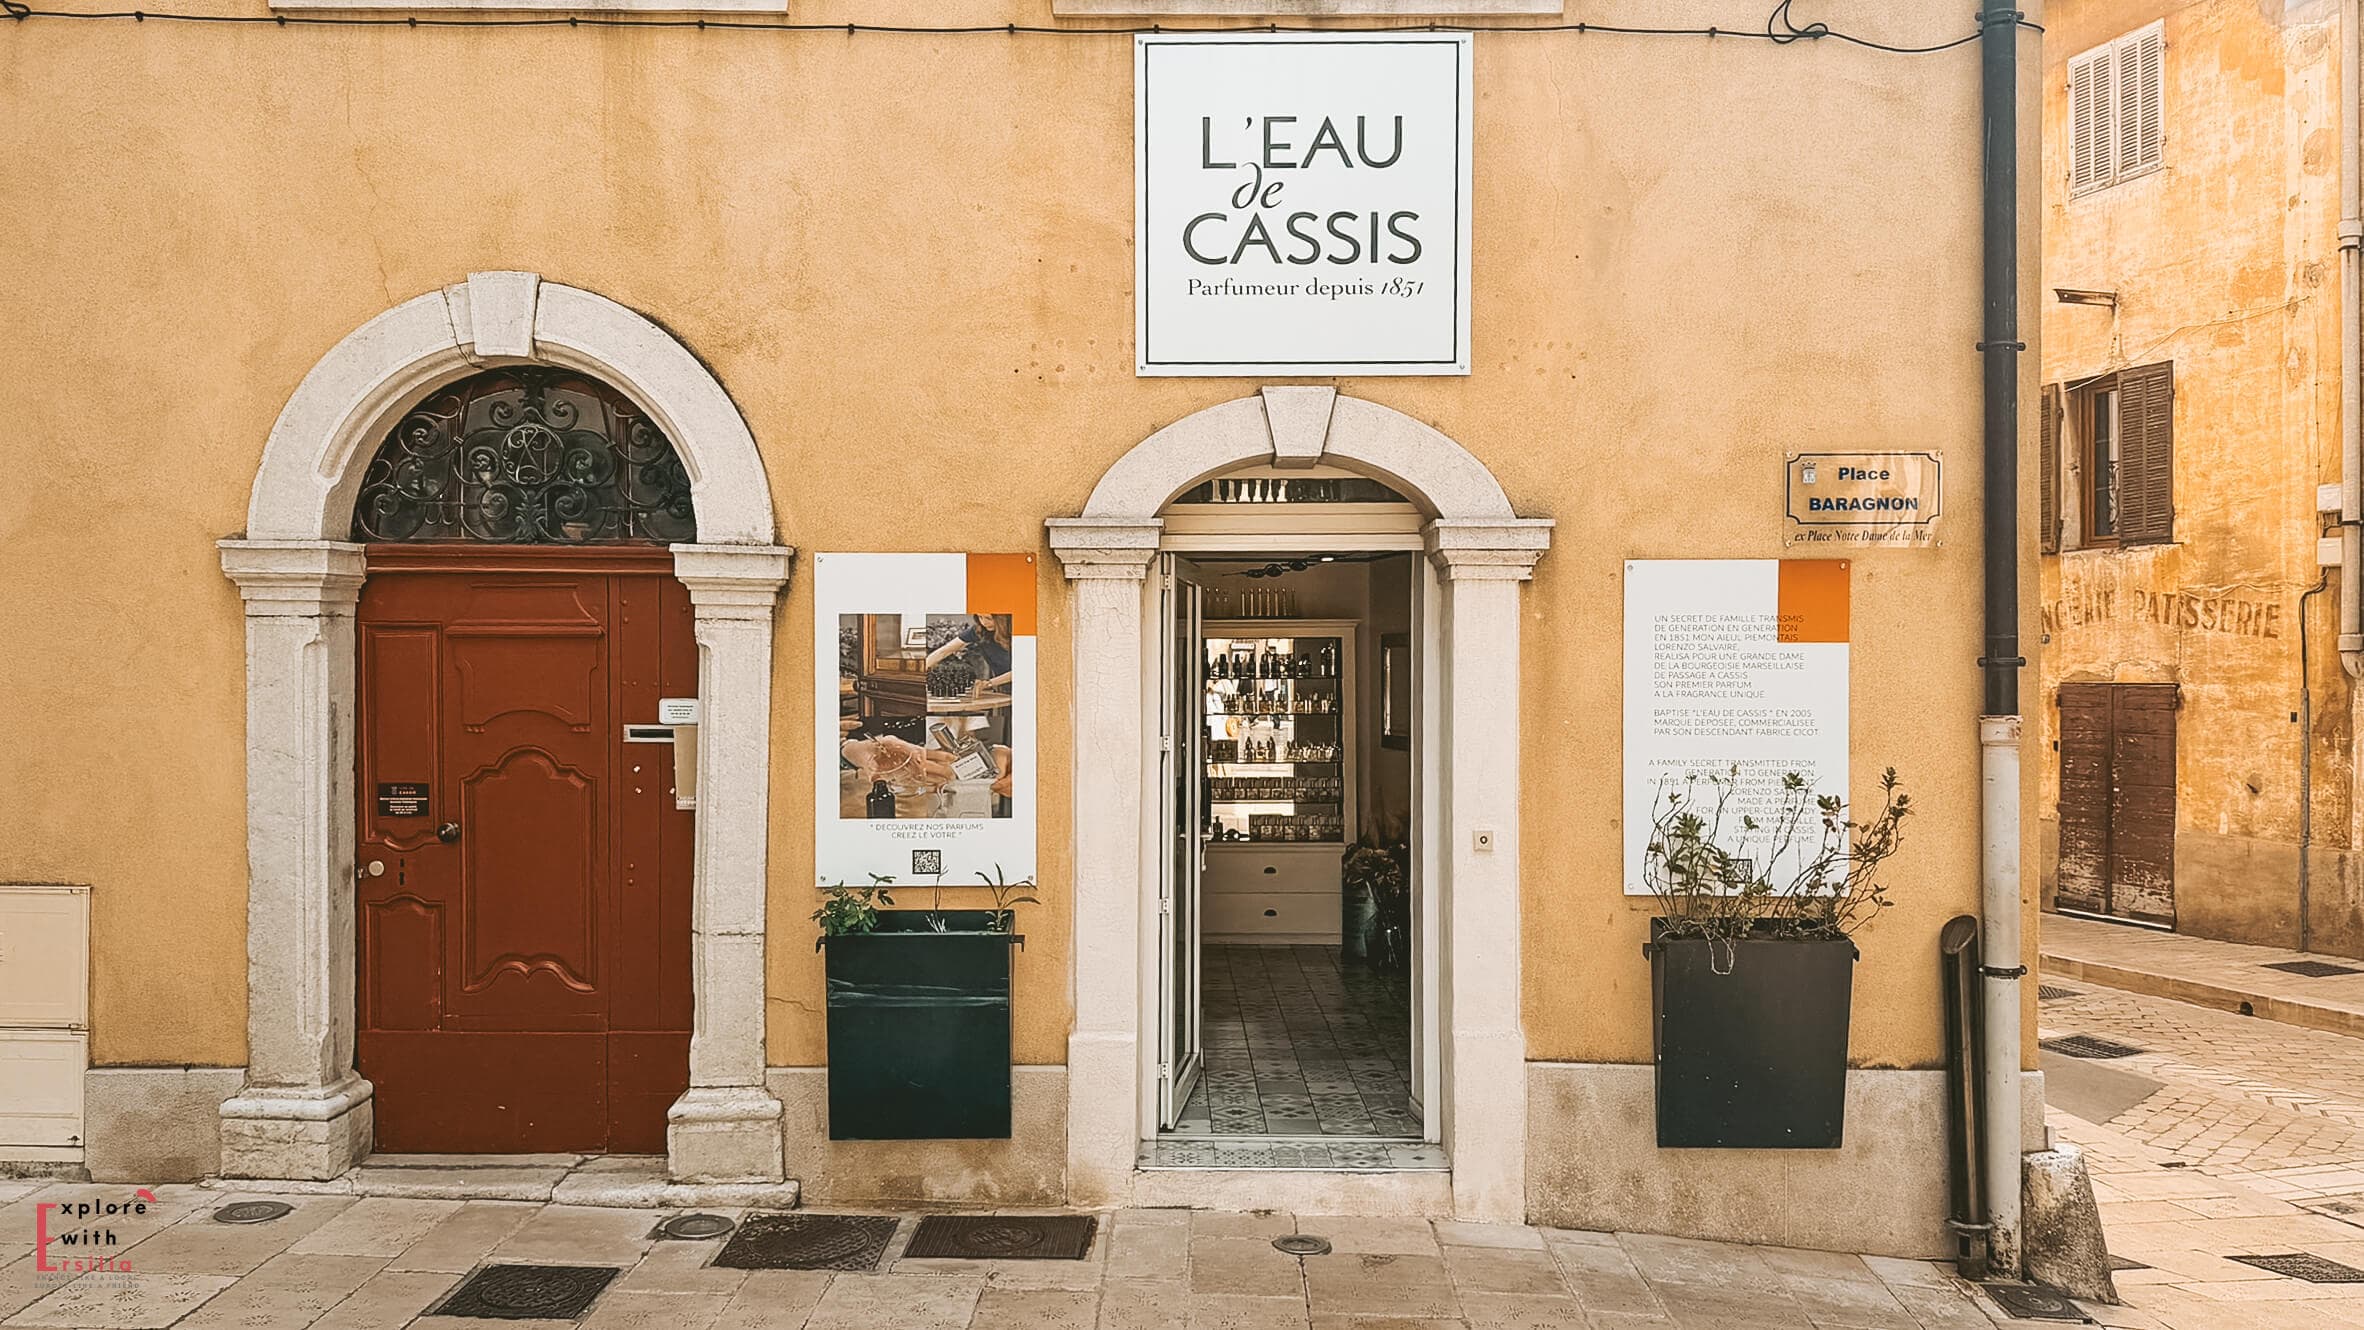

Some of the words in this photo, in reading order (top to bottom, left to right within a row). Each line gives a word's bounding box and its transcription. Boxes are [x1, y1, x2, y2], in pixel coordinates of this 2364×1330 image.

[1202, 115, 1402, 169] L'EAU
[1231, 162, 1284, 209] de
[1182, 211, 1422, 265] CASSIS
[1187, 277, 1300, 296] Parfumeur
[1305, 276, 1374, 300] depuis
[1380, 277, 1424, 298] 1851
[1838, 467, 1890, 481] Place
[1808, 497, 1919, 511] BARAGNON
[1794, 533, 1806, 542] ex
[1807, 530, 1833, 542] Place
[1835, 530, 1860, 541] Notre
[1861, 530, 1888, 541] Dame
[1889, 530, 1901, 541] de
[1914, 530, 1933, 541] Mer
[1654, 615, 1668, 623] UN
[1670, 615, 1703, 623] SECRET
[1705, 615, 1717, 623] DE
[1719, 615, 1756, 623] FAMILLE
[1759, 615, 1805, 623] TRANSMIS
[1654, 624, 1667, 632] DE
[1668, 624, 1725, 632] GENERATION
[1727, 624, 1740, 632] EN
[1741, 624, 1798, 632] GENERATION
[1654, 633, 1667, 641] EN
[1692, 633, 1715, 641] MON
[1744, 633, 1799, 641] PIEMONTAIS
[1654, 643, 1696, 651] LORENZO
[1654, 662, 1666, 670] DE
[1668, 662, 1680, 670] LA
[1681, 662, 1740, 670] BOURGEOISIE
[1742, 662, 1805, 670] MARSEILLAISE
[1654, 681, 1673, 689] SON
[1675, 681, 1714, 689] PREMIER
[1715, 681, 1752, 689] PARFUM
[1662, 690, 1674, 698] LA
[1676, 690, 1728, 698] FRAGRANCE
[1730, 690, 1765, 698] UNIQUE
[1654, 709, 1689, 717] BAPTISE
[1722, 709, 1735, 717] DE
[1775, 709, 1788, 717] EN
[1790, 709, 1812, 717] 2005
[1654, 718, 1693, 727] MARQUE
[1738, 718, 1815, 727] COMMERCIALISEE
[1654, 728, 1671, 736] PAR
[1672, 728, 1692, 736] SON
[1694, 728, 1753, 736] DESCENDANT
[1755, 728, 1791, 736] FABRICE
[1793, 728, 1819, 736] CICOT
[1657, 759, 1688, 767] FAMILY
[1690, 759, 1722, 767] SECRET
[1725, 759, 1789, 767] TRANSMITTED
[1790, 759, 1816, 767] FROM
[1744, 769, 1756, 777] TO
[1740, 778, 1766, 786] FROM
[1737, 797, 1764, 805] MADE
[1696, 807, 1714, 815] FOR
[875, 824, 924, 832] DECOUVREZ
[945, 824, 984, 832] PARFUMS
